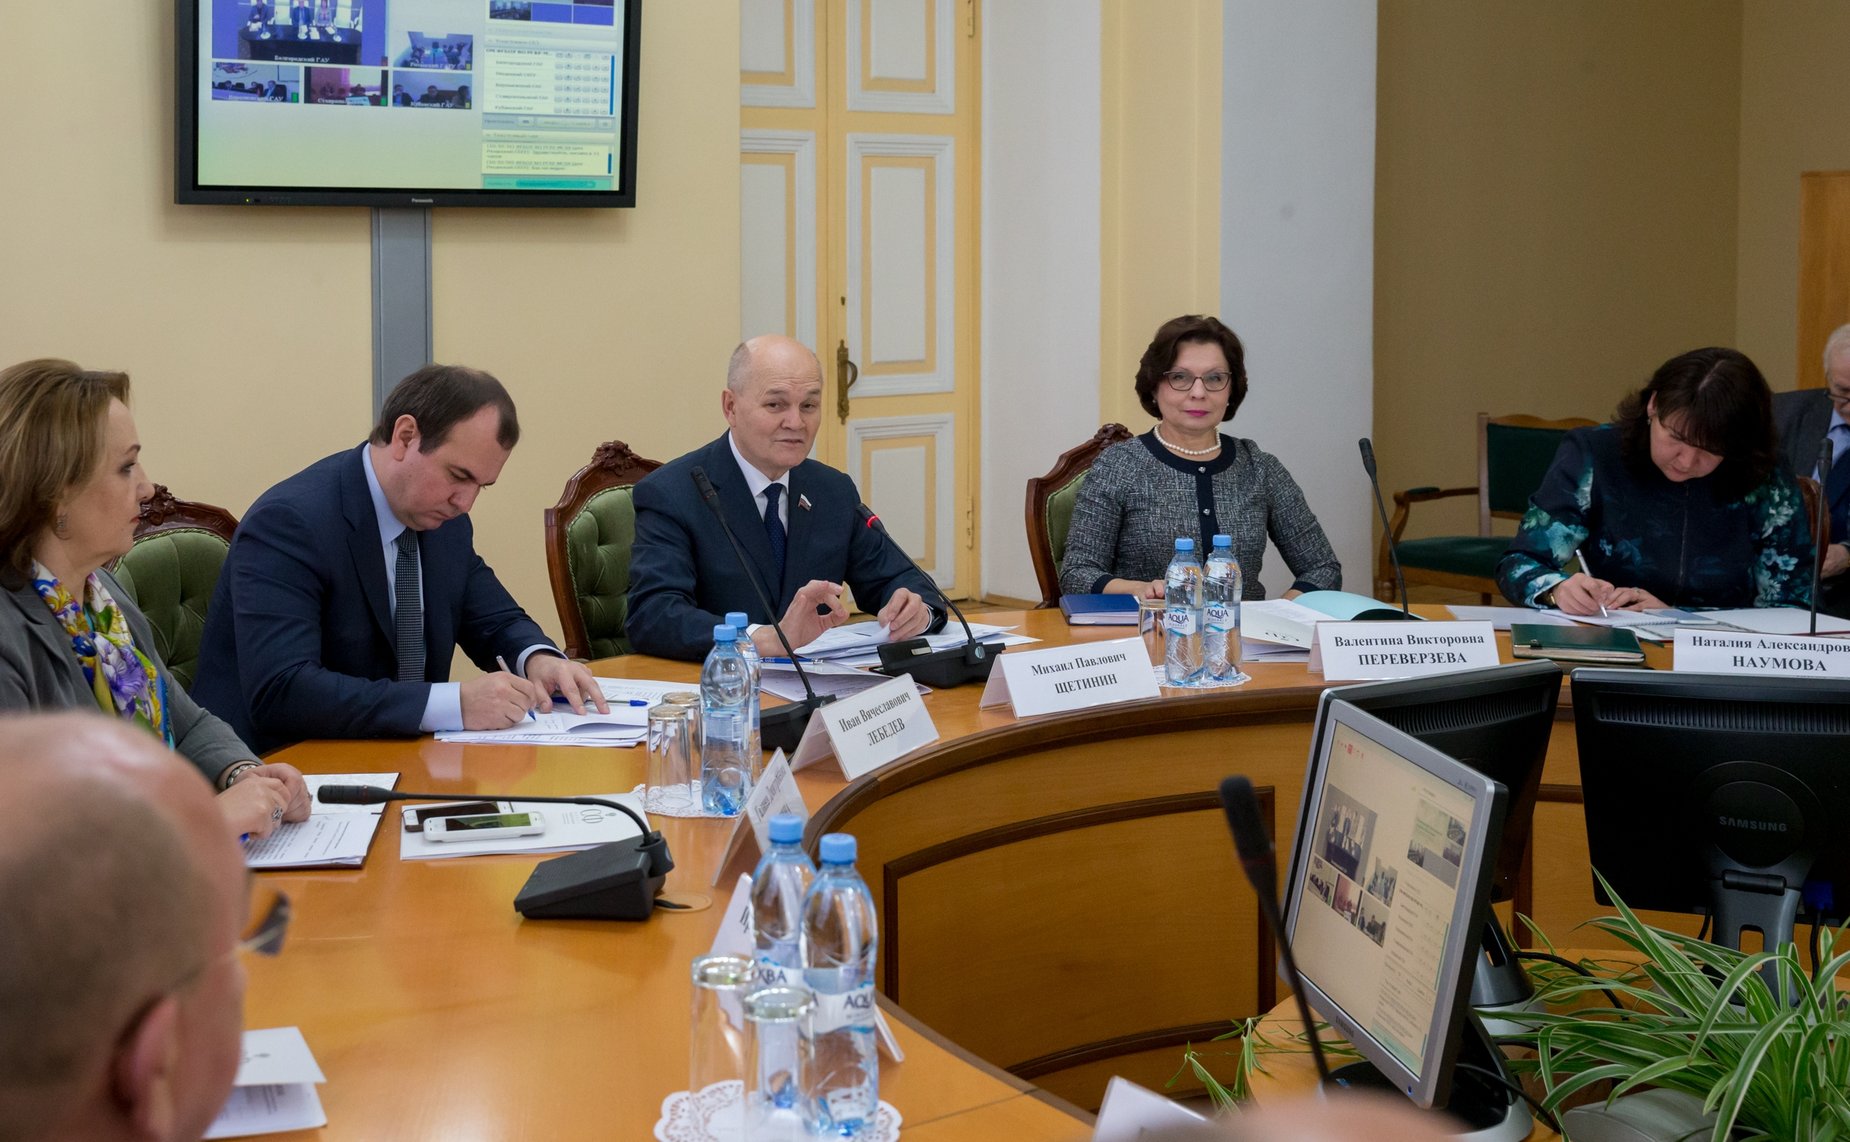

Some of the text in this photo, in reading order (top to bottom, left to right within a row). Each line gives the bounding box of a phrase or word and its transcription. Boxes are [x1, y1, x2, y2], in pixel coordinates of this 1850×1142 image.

[1168, 613, 1190, 624] AQUA
[1206, 607, 1229, 619] AQUA
[1334, 634, 1485, 648] Валентина Викторовна
[1692, 636, 1752, 649] Наталия
[1031, 653, 1127, 676] Михаил Павлович
[1358, 652, 1468, 666] ПЕРЕВЕРЗЕВА
[1733, 655, 1828, 672] НАУМОВА
[1054, 673, 1119, 694] ЩЕТИНИН
[838, 691, 911, 733] Иван Вячеславович
[867, 717, 906, 746] ЛЕБЕДЕВ
[1719, 815, 1788, 833] SAMSUNG
[843, 992, 874, 1010] AQU
